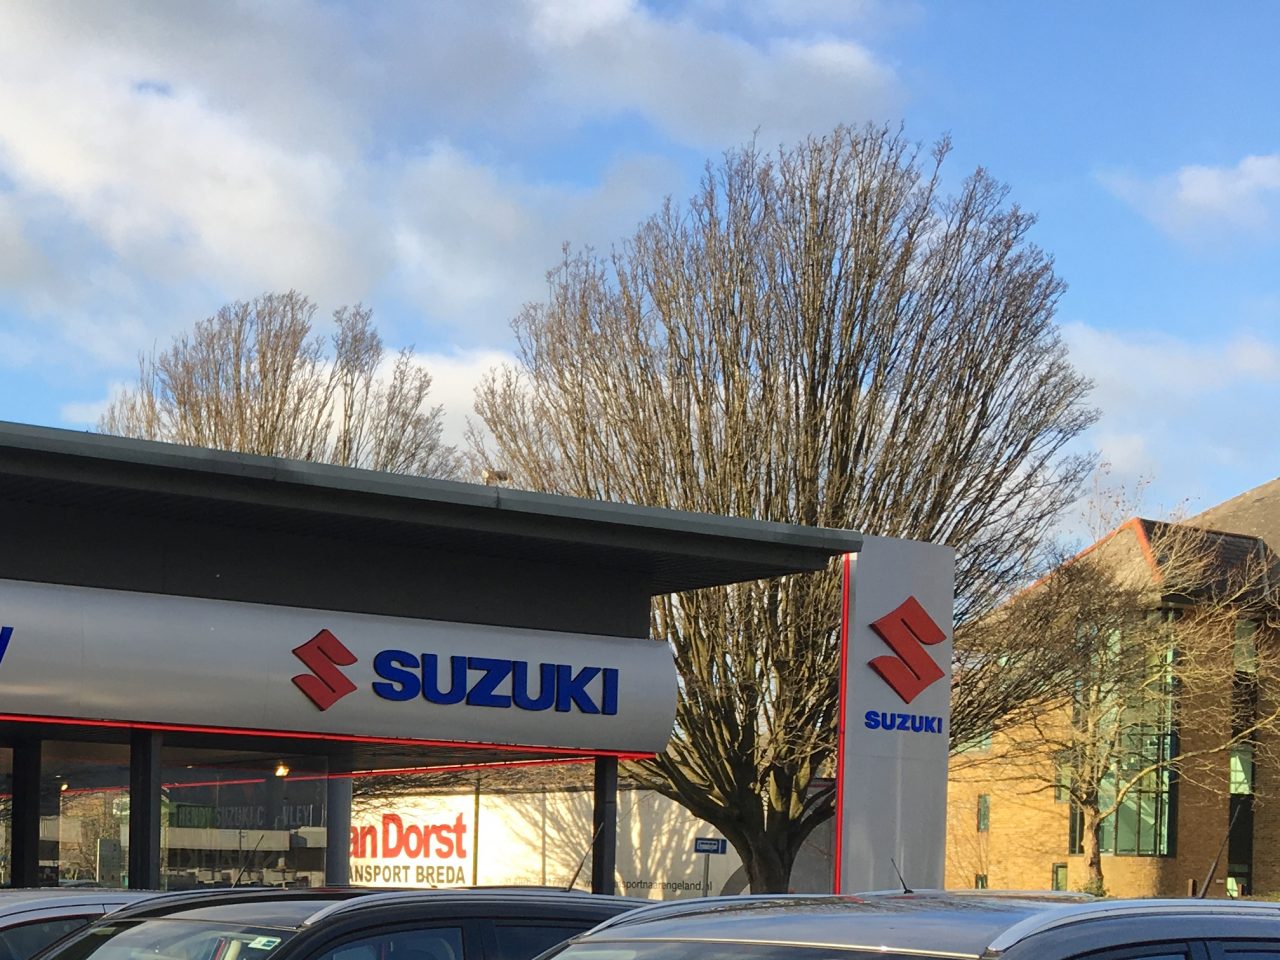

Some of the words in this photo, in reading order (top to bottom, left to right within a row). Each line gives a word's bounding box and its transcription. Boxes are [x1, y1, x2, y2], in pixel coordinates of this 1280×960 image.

[372, 649, 619, 715] SUZUKI
[864, 710, 943, 734] SUZUKI
[382, 812, 467, 858] Dorst
[416, 865, 466, 884] BREDA
